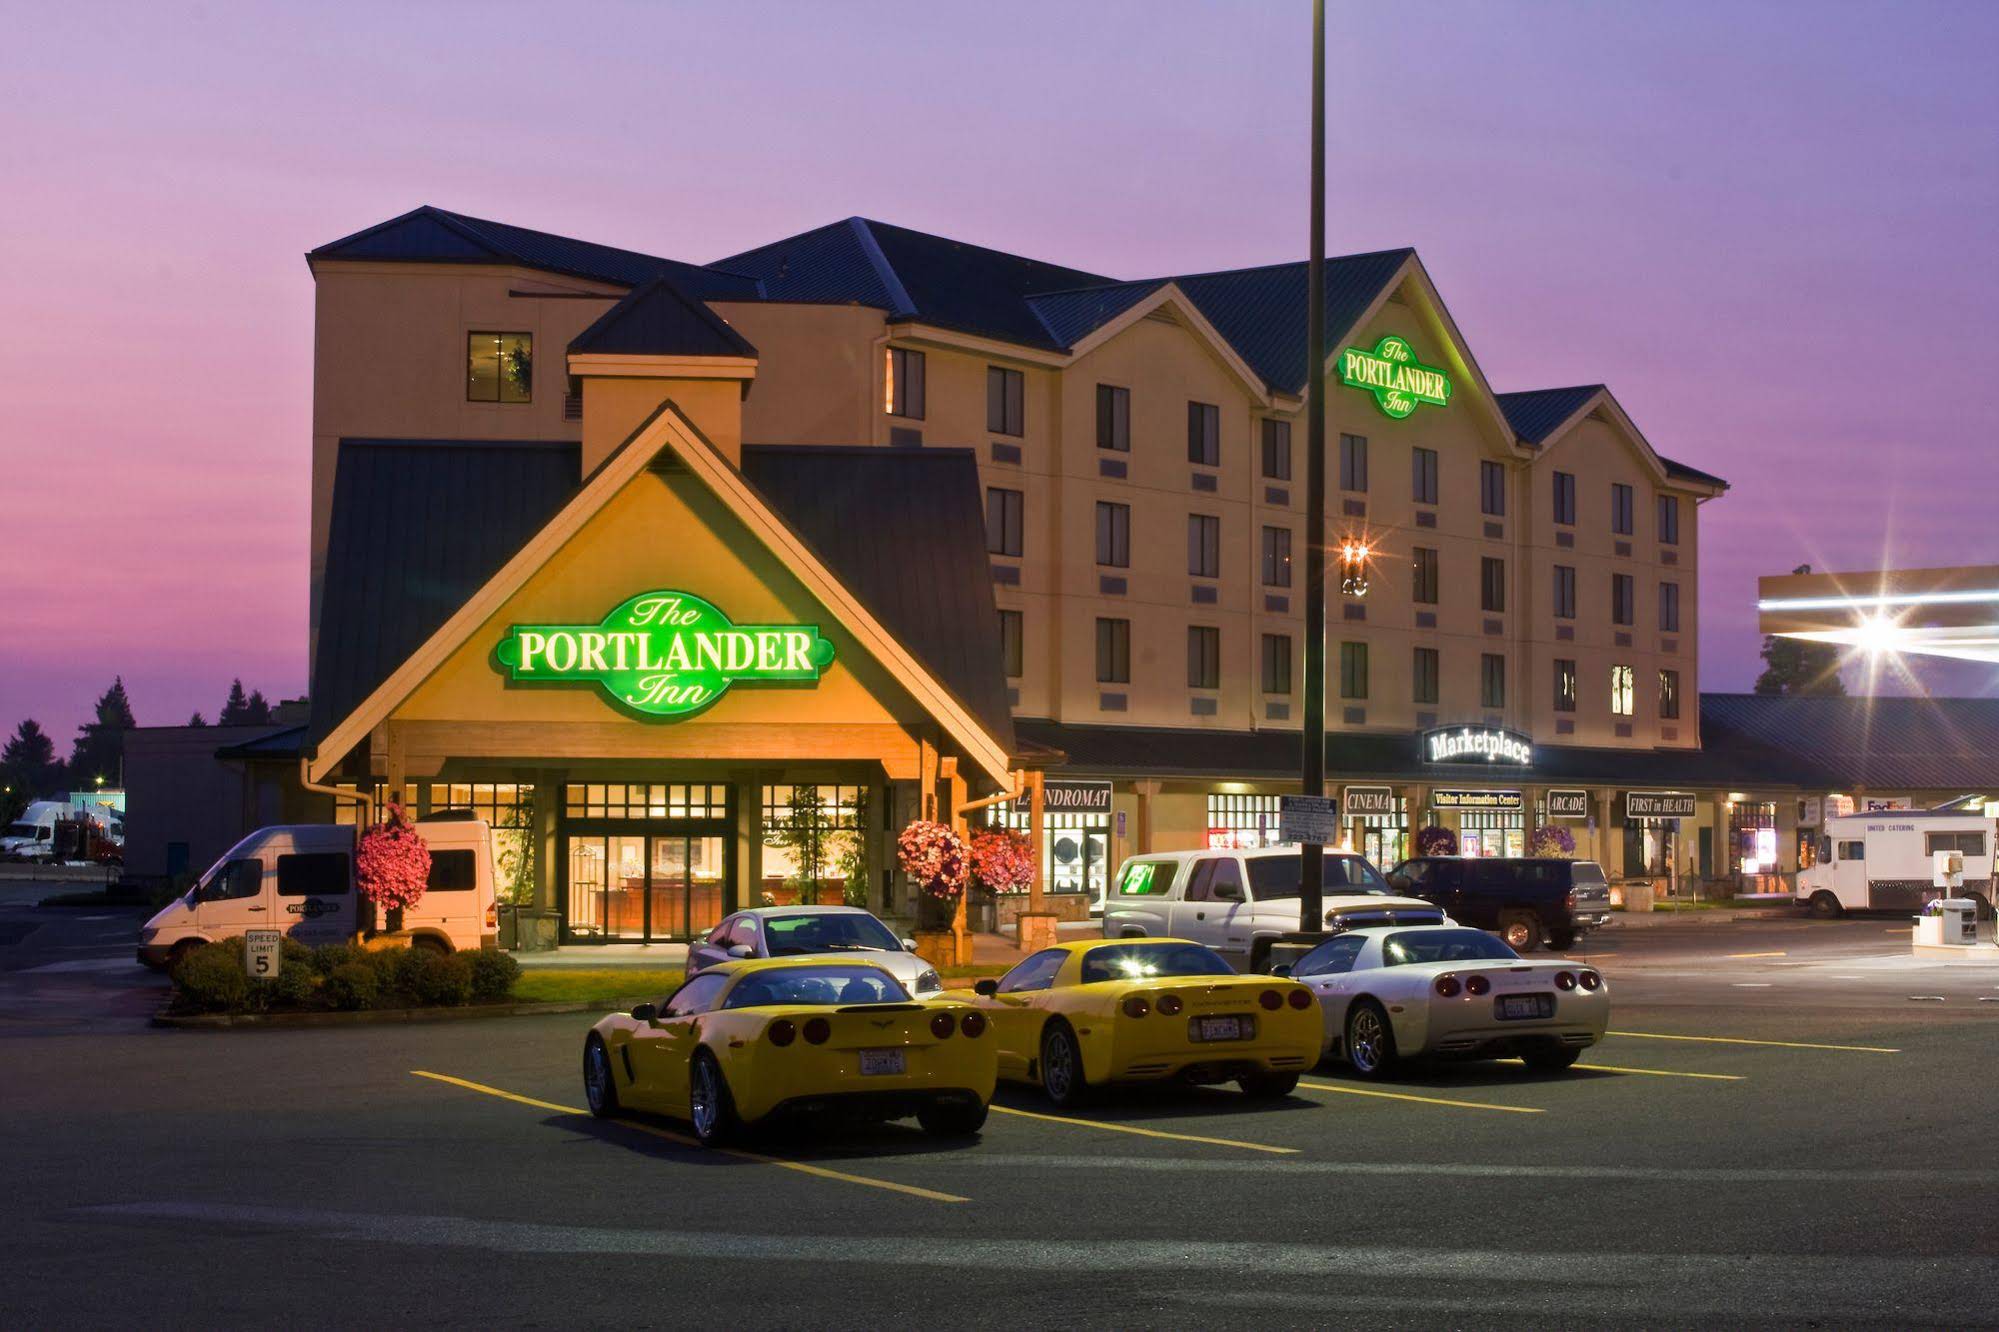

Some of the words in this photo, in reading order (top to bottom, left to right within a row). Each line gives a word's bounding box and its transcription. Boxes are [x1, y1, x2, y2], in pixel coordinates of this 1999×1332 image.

[1383, 341, 1409, 362] The
[1346, 353, 1445, 400] PORTLANDER
[1383, 391, 1412, 412] Inn
[629, 598, 702, 625] The
[518, 631, 814, 672] PORTLANDER
[626, 674, 713, 705] Inn
[1430, 728, 1530, 764] Marketplace
[1016, 788, 1110, 807] LNDROMAT
[1347, 793, 1389, 809] CINEMA
[1435, 793, 1458, 804] Visitor
[1459, 794, 1497, 805] Information
[1498, 794, 1520, 805] Center
[1551, 796, 1585, 811] ARCADE
[1630, 798, 1652, 812] FIRST
[1653, 800, 1662, 812] in
[1662, 799, 1694, 813] HEALTH
[289, 904, 335, 913] PORTLA
[248, 934, 278, 942] SPEED
[256, 955, 269, 973] 5
